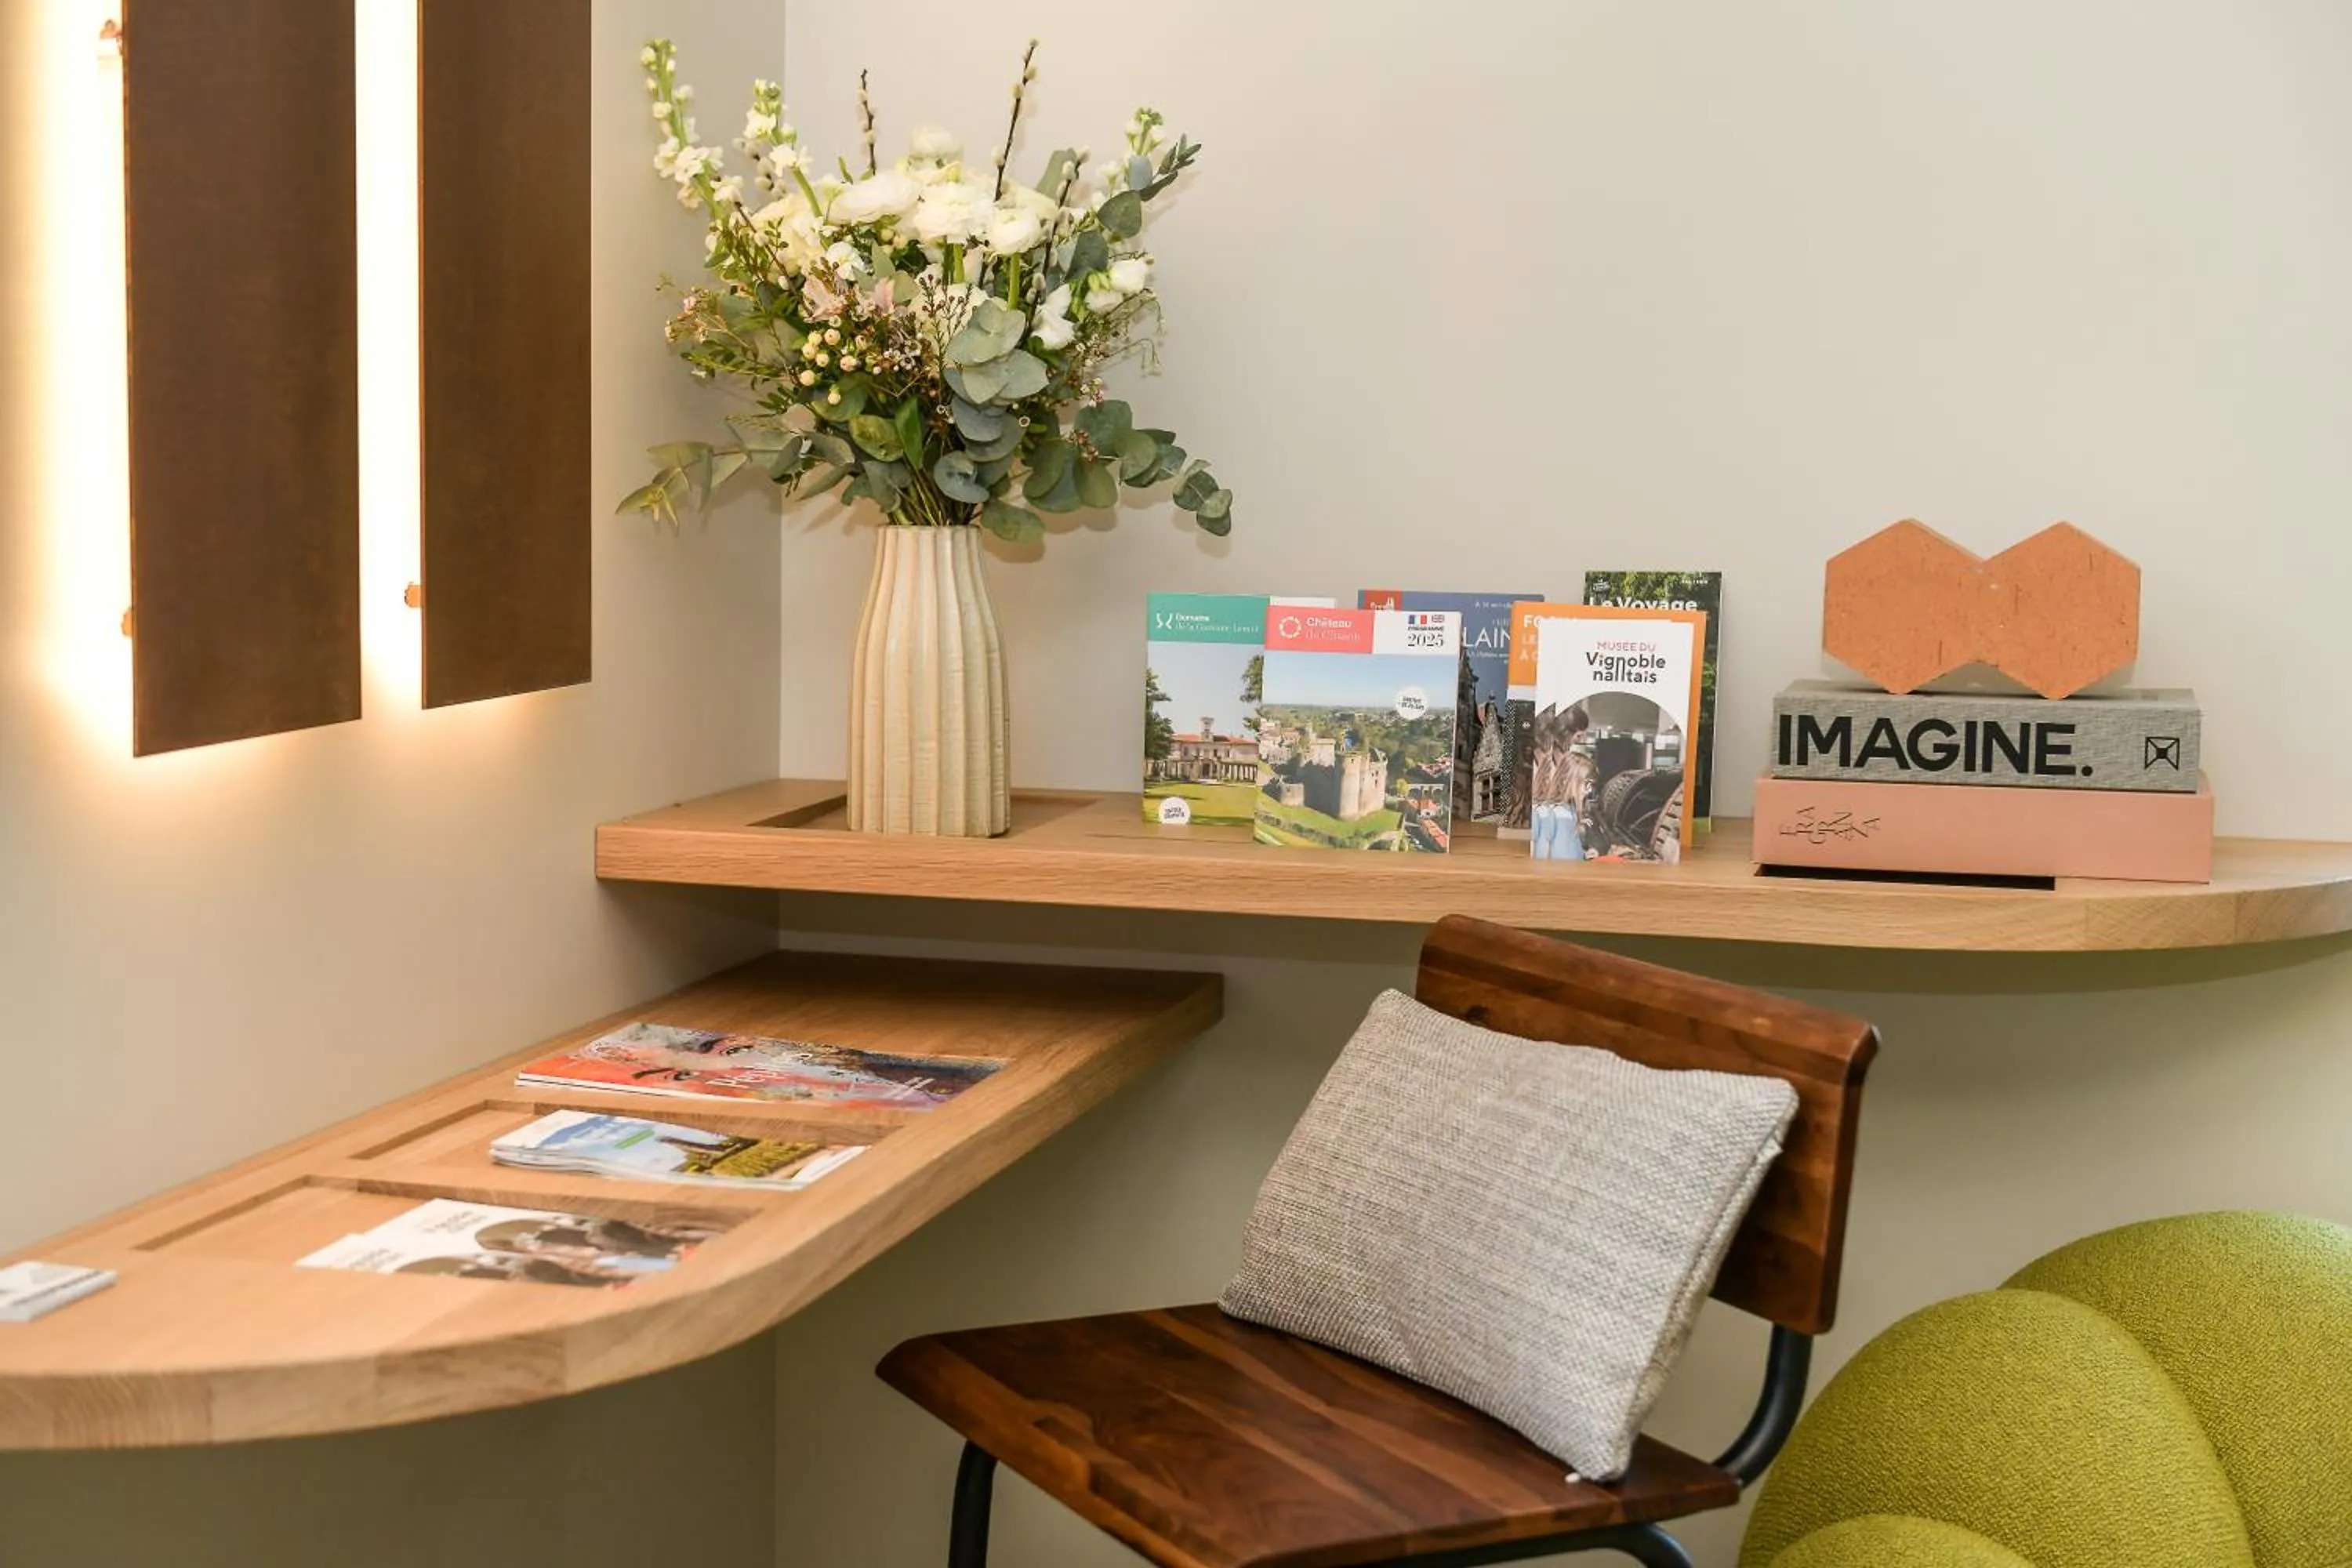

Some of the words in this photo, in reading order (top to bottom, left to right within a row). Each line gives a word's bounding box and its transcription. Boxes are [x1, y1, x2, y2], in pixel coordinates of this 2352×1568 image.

[1617, 597, 1698, 612] Voyage
[1407, 633, 1444, 648] 2025
[1639, 642, 1656, 652] DU
[1585, 652, 1667, 672] Vignoble
[1778, 713, 2094, 778] IMAGINE.
